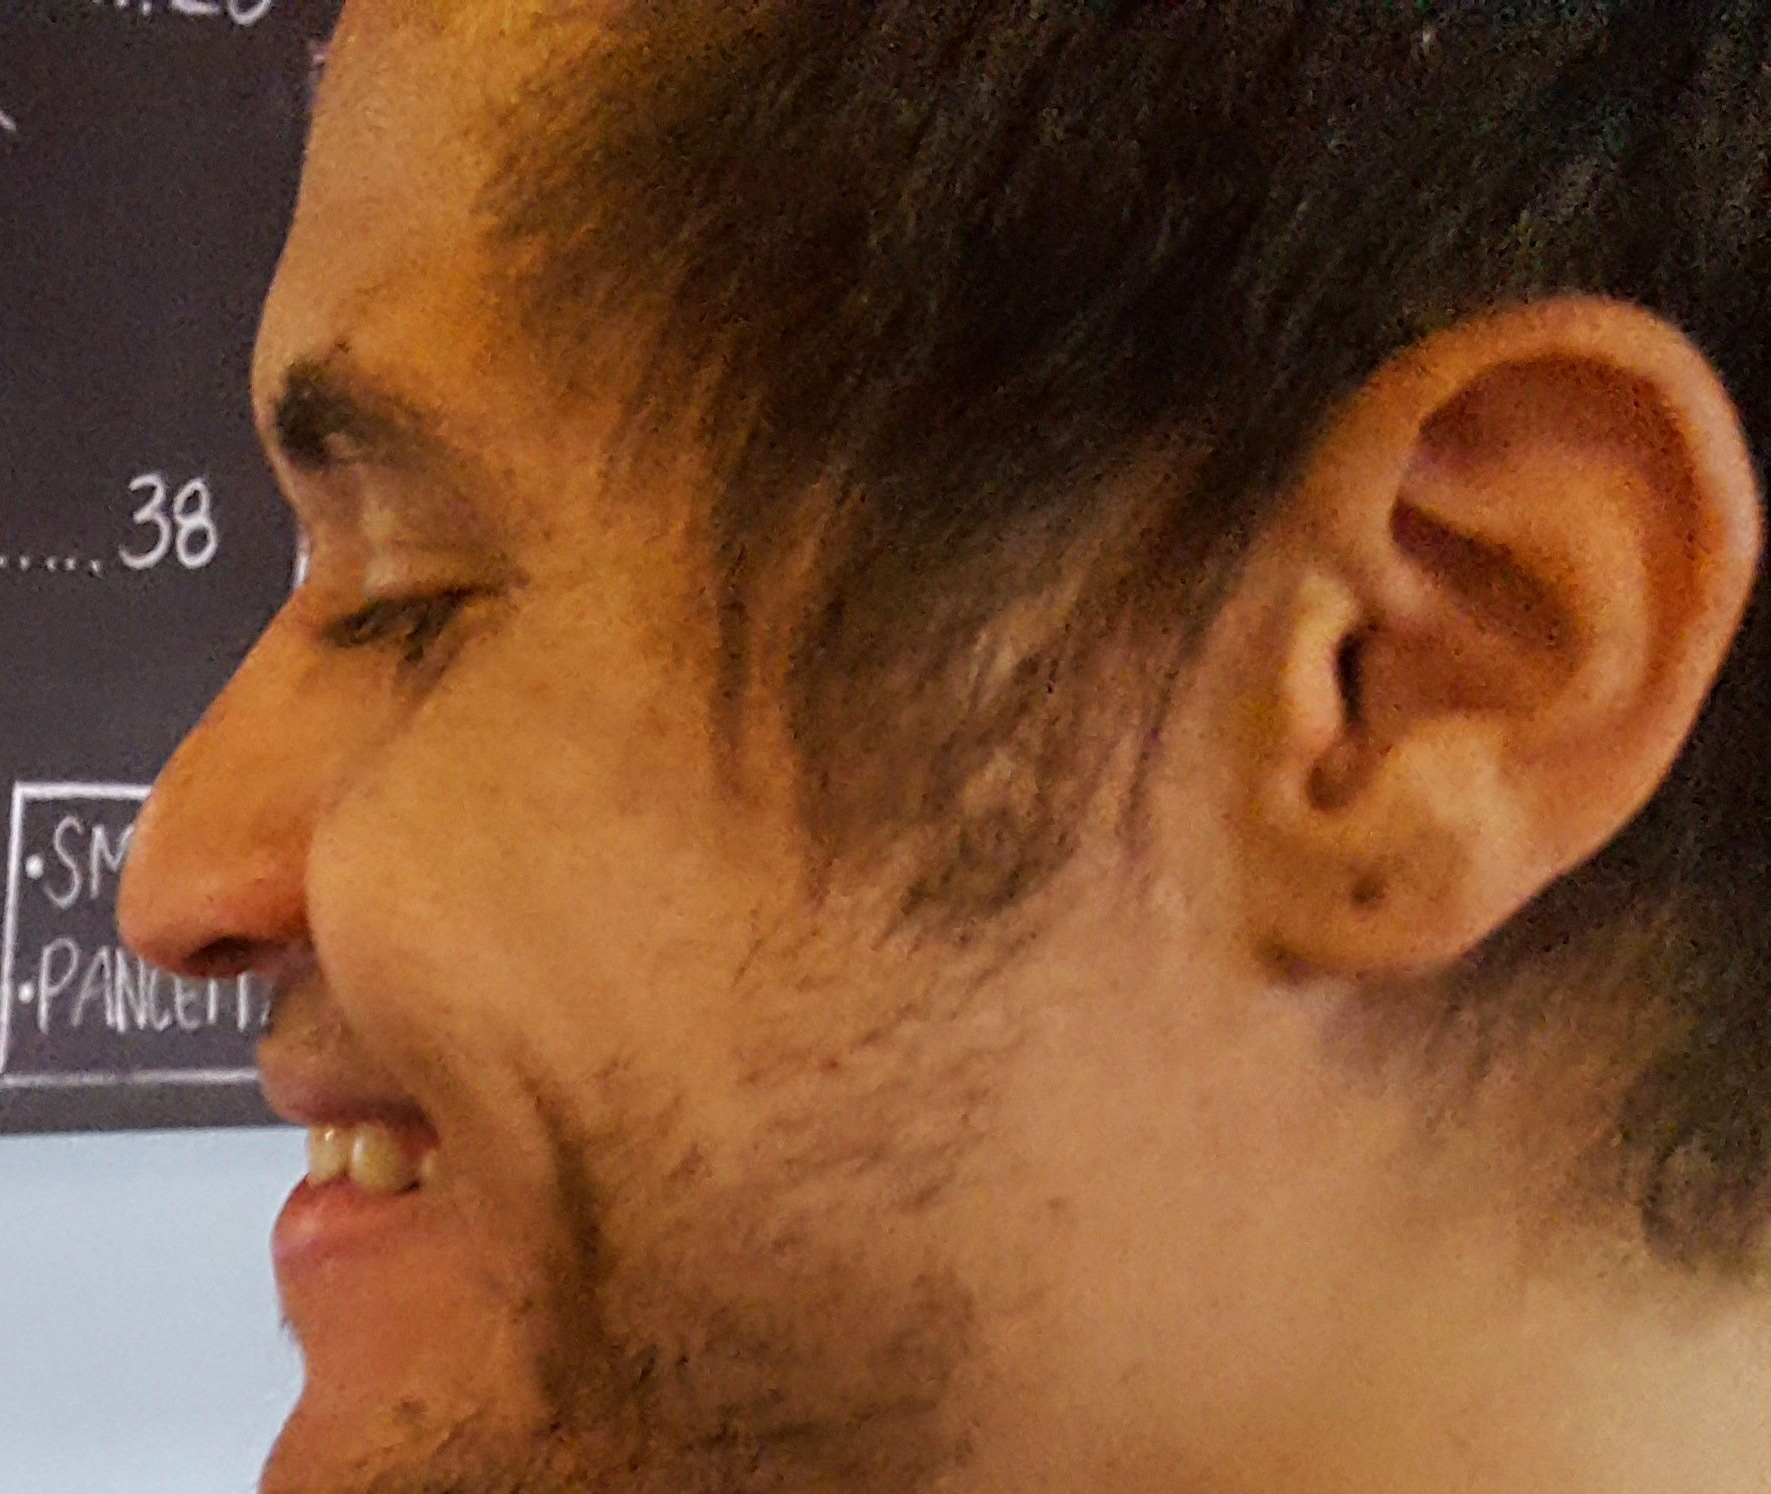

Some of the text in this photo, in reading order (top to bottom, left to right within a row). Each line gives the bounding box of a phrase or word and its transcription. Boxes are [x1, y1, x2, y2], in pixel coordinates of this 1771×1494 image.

[117, 472, 220, 571] 38
[42, 813, 136, 910] SM
[36, 937, 275, 1034] PANCE
